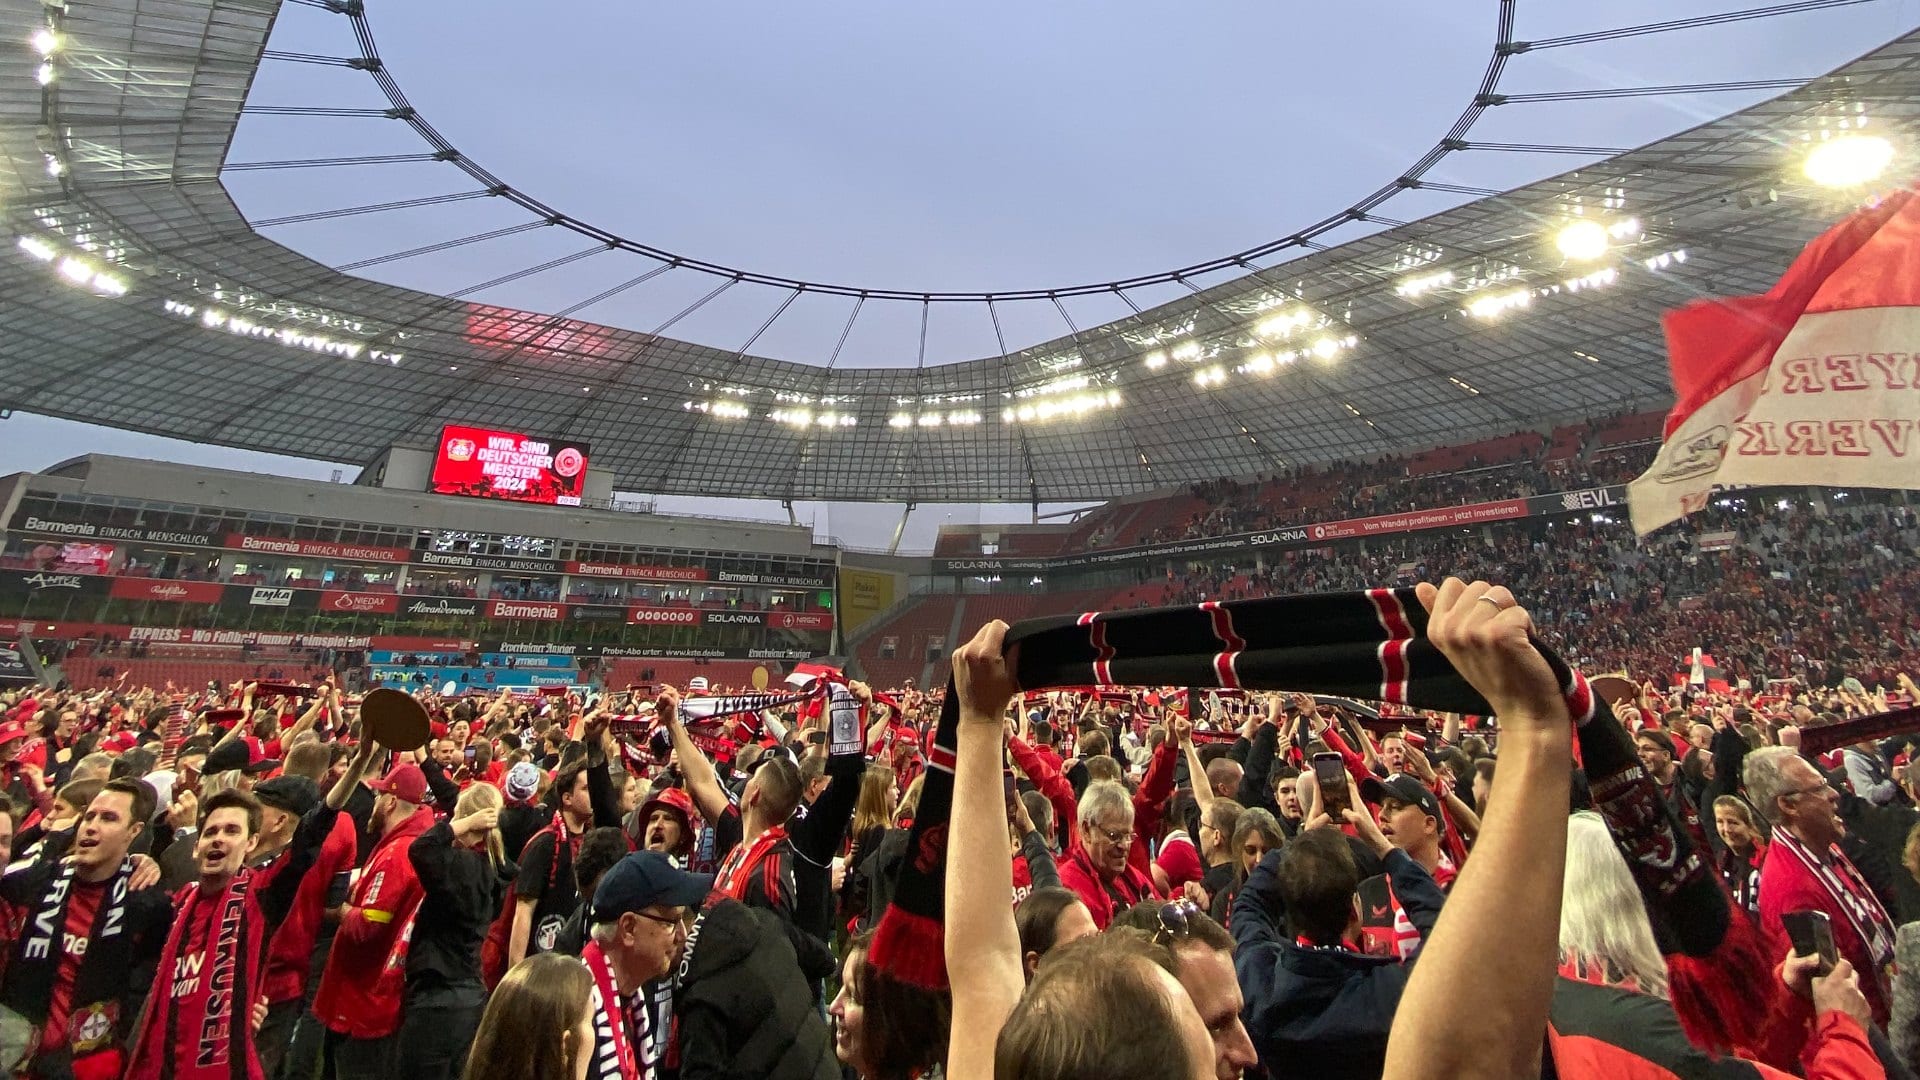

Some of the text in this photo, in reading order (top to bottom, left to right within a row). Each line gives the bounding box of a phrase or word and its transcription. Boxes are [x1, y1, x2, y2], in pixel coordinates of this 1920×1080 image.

[487, 436, 550, 455] WIR. SIND
[477, 448, 554, 469] DEUTSCHER
[482, 461, 542, 480] MEISTER.
[493, 476, 528, 491] 2024
[1579, 489, 1617, 509] EVL
[1363, 521, 1379, 531] Vom
[1380, 518, 1409, 529] Wandel
[1409, 514, 1448, 528] profitieren
[1454, 510, 1472, 522] jetzt
[1474, 505, 1519, 518] investieren
[24, 517, 211, 545] Barmenia EINFACH. MENSCHLICH.
[1250, 530, 1308, 545] SOLARNIA
[241, 537, 396, 560] Barmenia EINFACH. MENSCHLICH.
[423, 551, 557, 571] Barmenia EINFACH. MENSCHLICH.
[948, 561, 1003, 569] SOLARNIA
[578, 563, 697, 579] Barmenia EINFACH. MENSCHLICH.
[719, 571, 825, 586] Barmenia EINFACH. MENSCHLICH.
[254, 589, 290, 600] EMKA
[354, 597, 386, 606] NIEDAX
[407, 600, 477, 616] Alexanderwerk
[494, 602, 559, 619] Barmenia
[707, 613, 761, 624] SOLARNIA
[128, 626, 182, 641] EXPRESS
[192, 629, 212, 643] Wo
[602, 647, 641, 656] Probe-Abo
